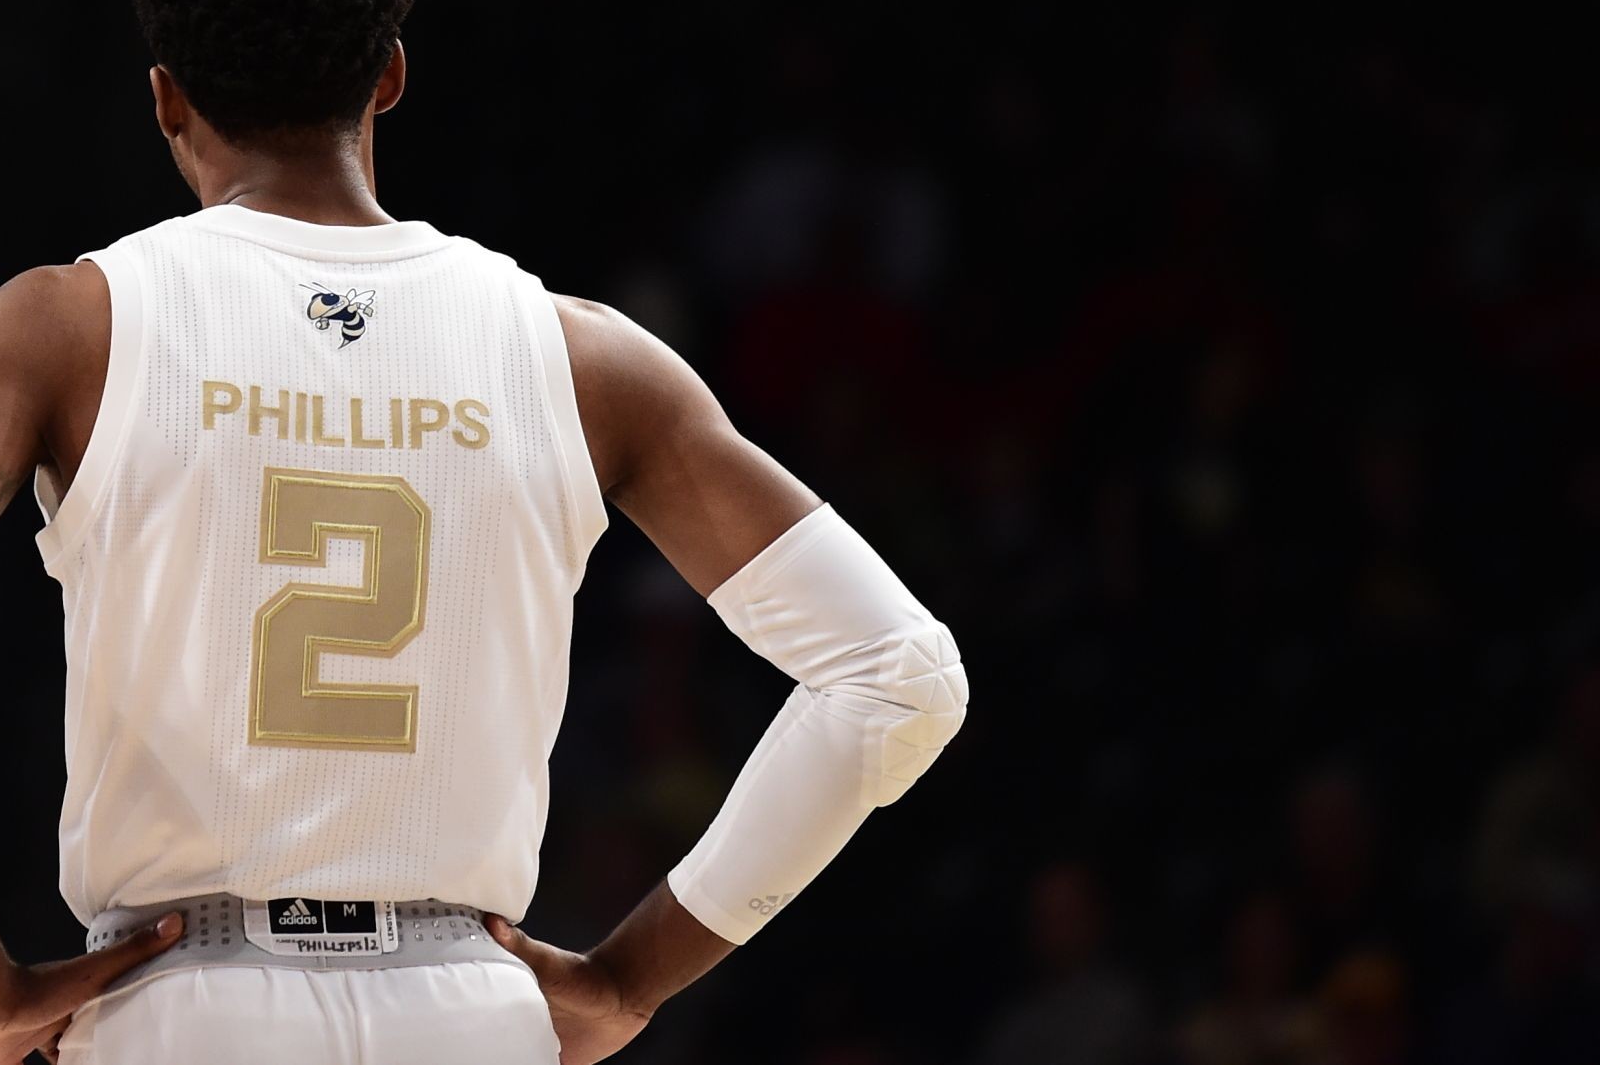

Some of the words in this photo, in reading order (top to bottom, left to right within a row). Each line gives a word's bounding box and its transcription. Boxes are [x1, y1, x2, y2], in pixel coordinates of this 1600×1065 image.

[202, 380, 492, 450] PHILLIPS
[248, 466, 432, 754] 2
[278, 916, 318, 926] adidas
[343, 903, 357, 917] M
[385, 911, 394, 942] LENGTH
